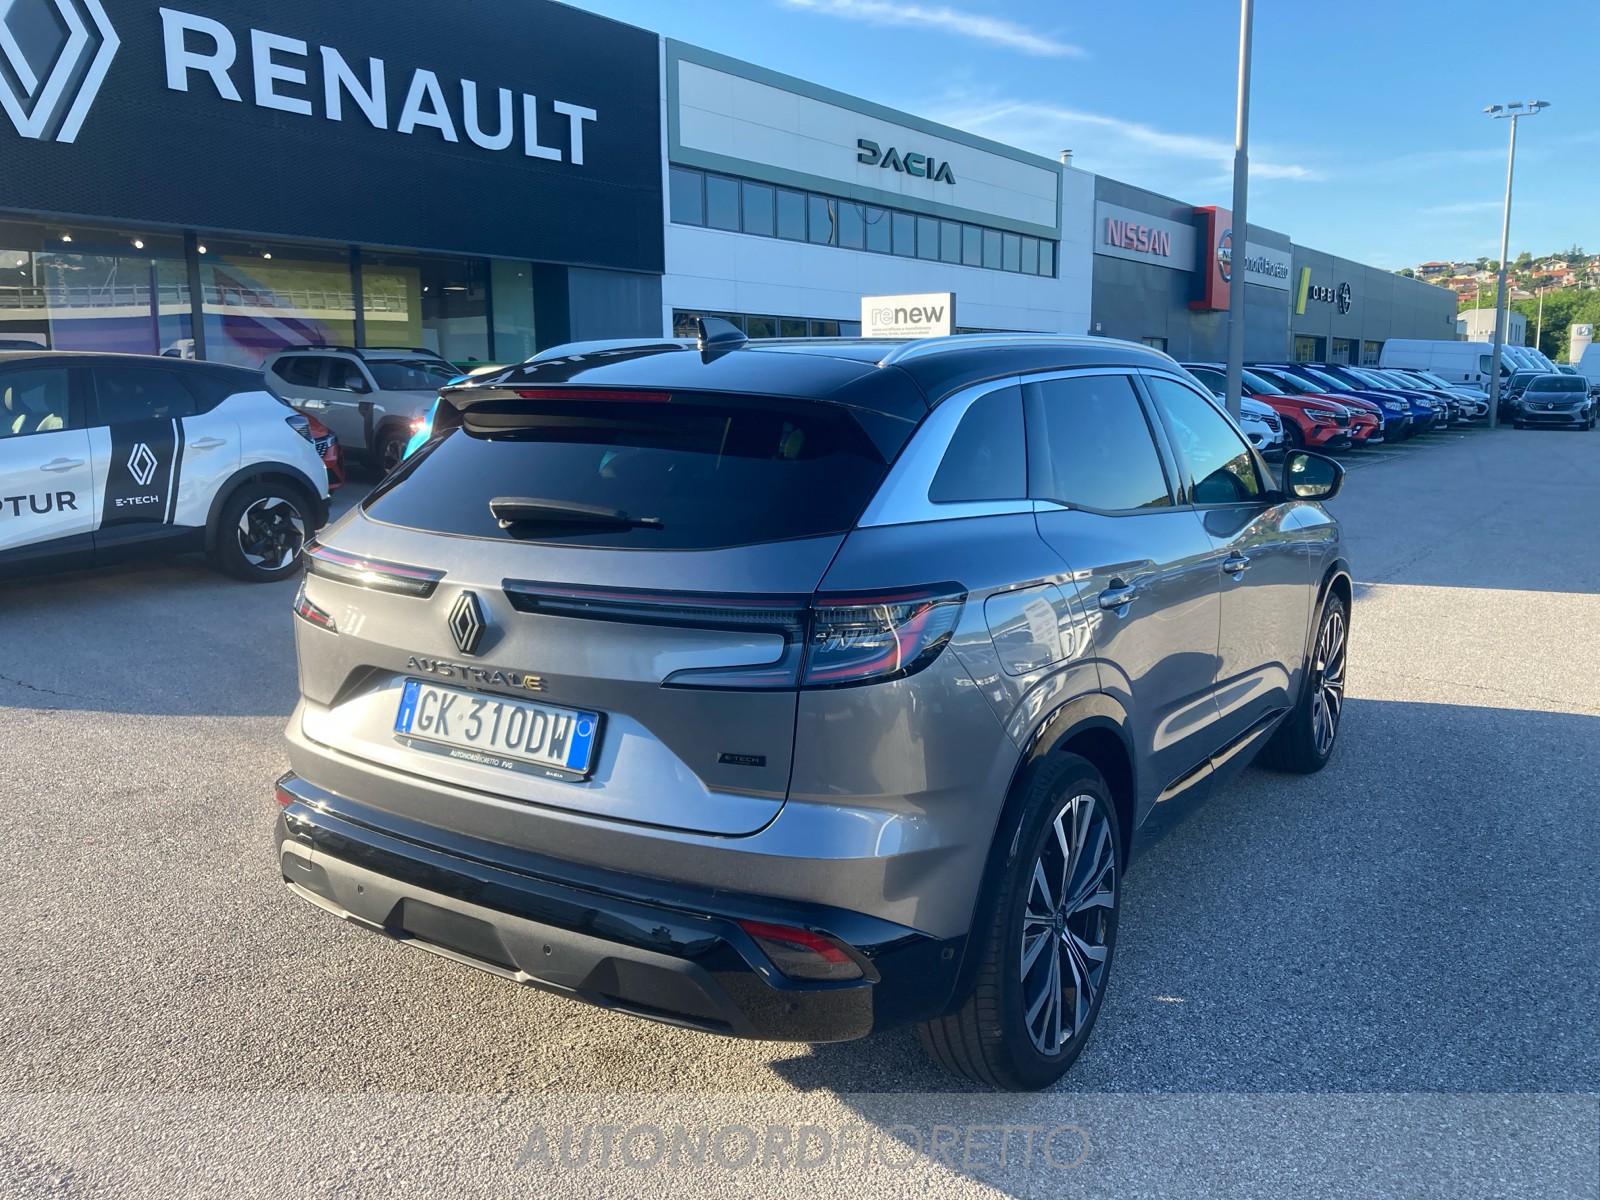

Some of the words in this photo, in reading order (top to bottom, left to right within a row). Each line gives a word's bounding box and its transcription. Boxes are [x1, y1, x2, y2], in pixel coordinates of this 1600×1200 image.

[159, 7, 597, 165] RENAULT
[857, 138, 956, 185] DACIA
[1105, 217, 1172, 257] NISSAN
[1311, 285, 1338, 303] OPEL
[871, 305, 945, 326] renew
[0, 491, 78, 516] TUR
[115, 495, 159, 507] E-TECH
[406, 655, 543, 691] AUSTRALE
